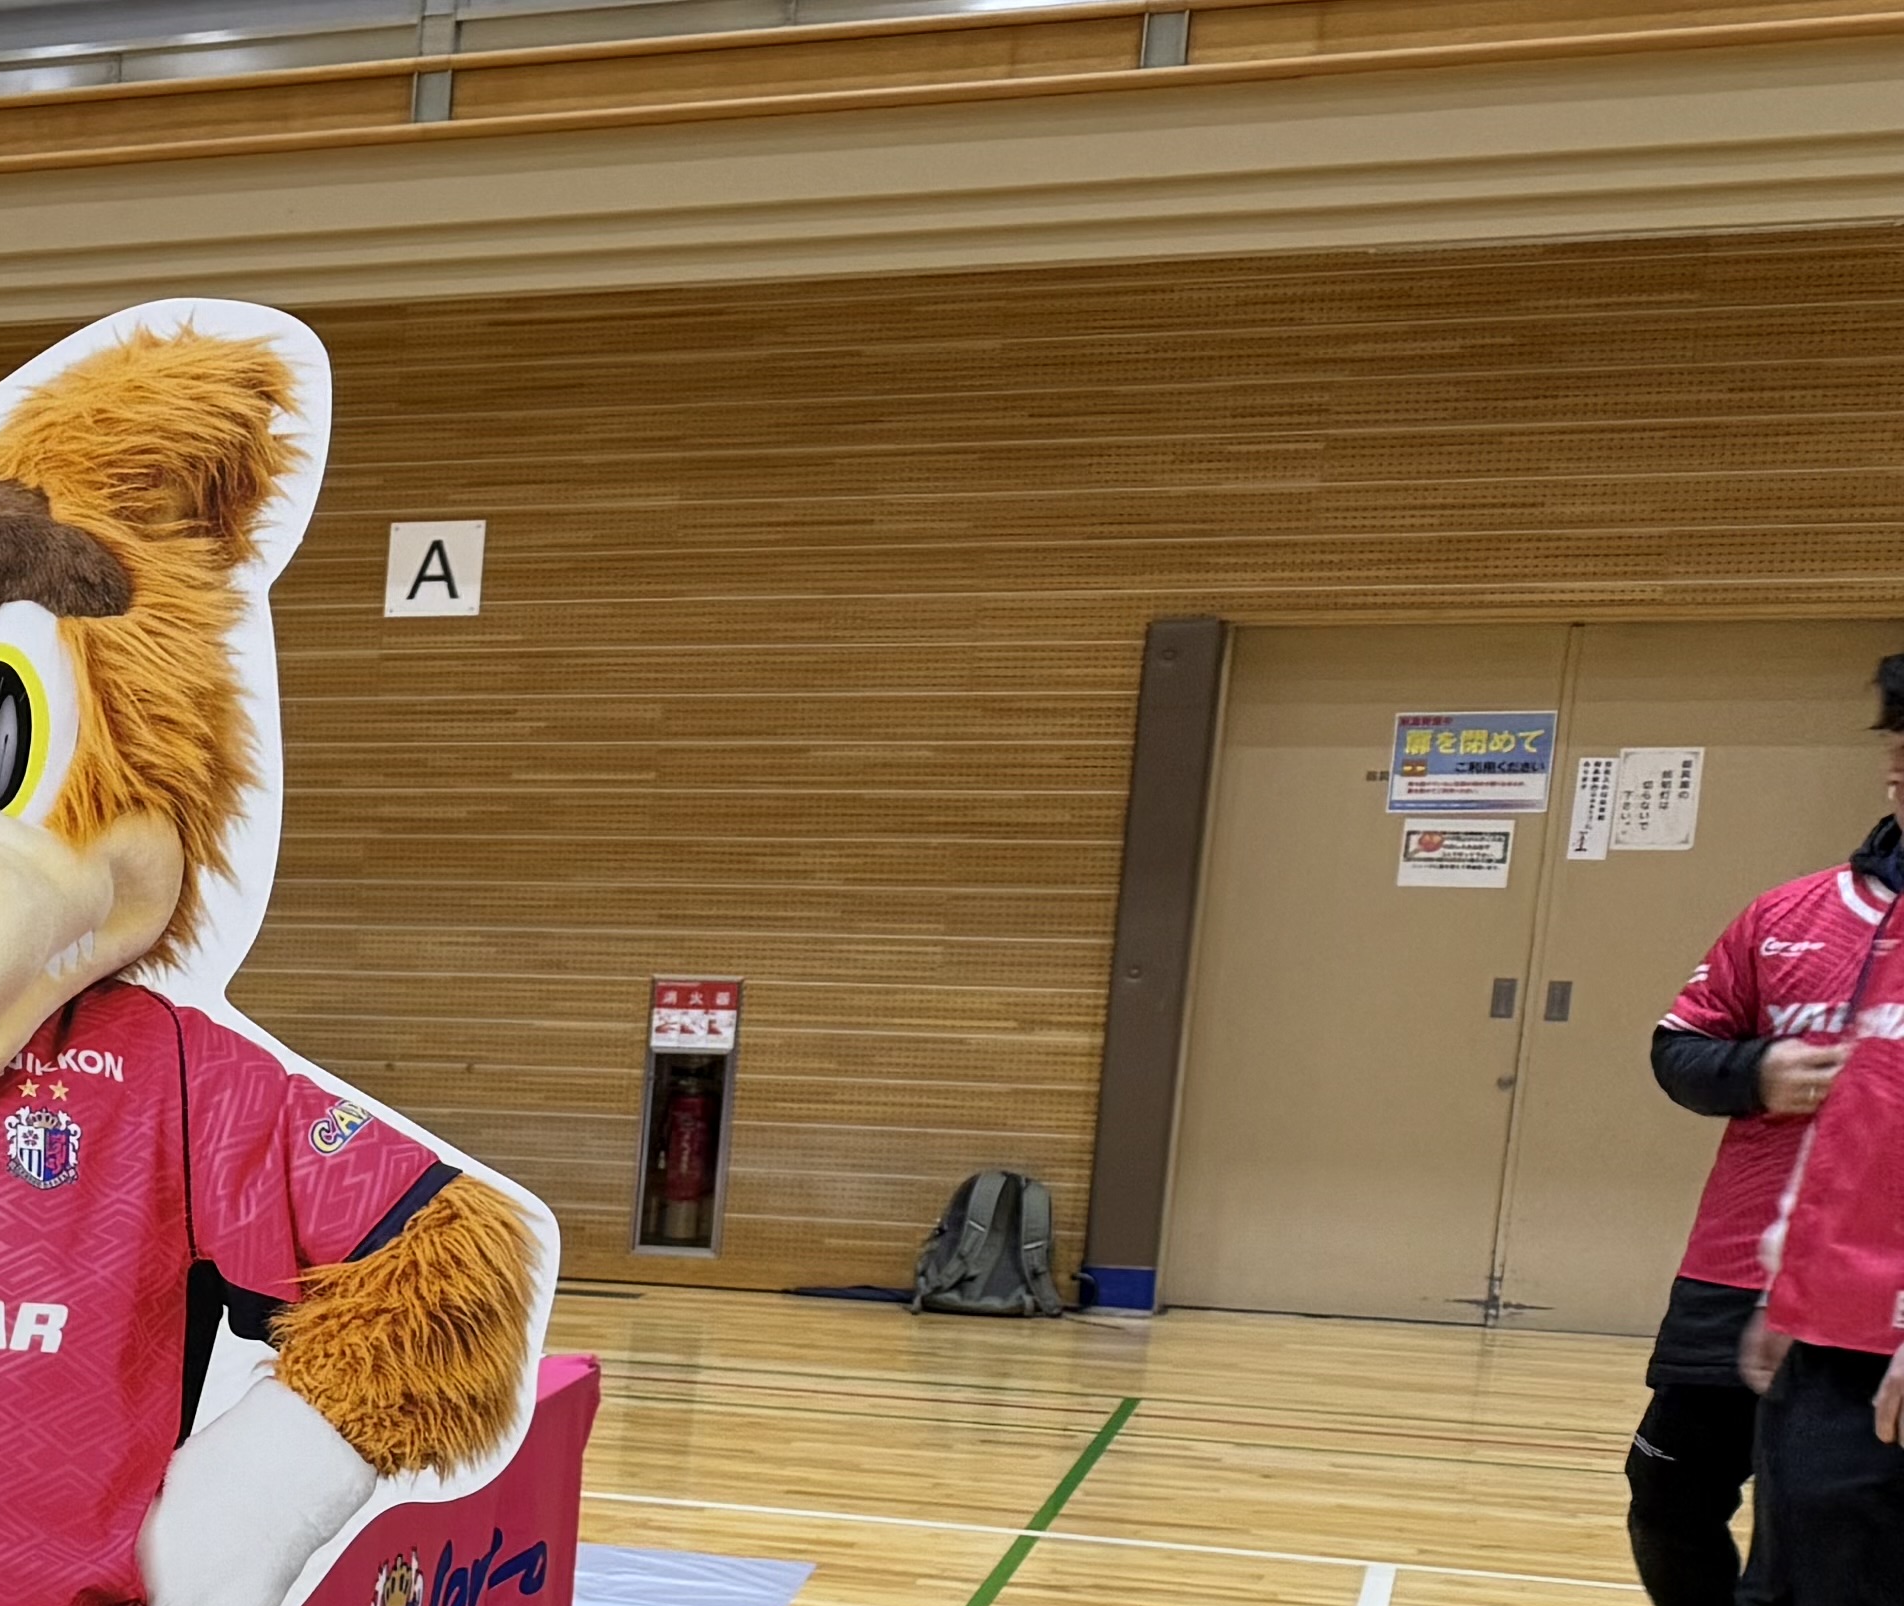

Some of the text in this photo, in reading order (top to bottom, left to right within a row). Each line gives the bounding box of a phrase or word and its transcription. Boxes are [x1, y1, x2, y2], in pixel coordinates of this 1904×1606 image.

[406, 539, 459, 600] A
[1405, 729, 1545, 755] 扉を閉めて
